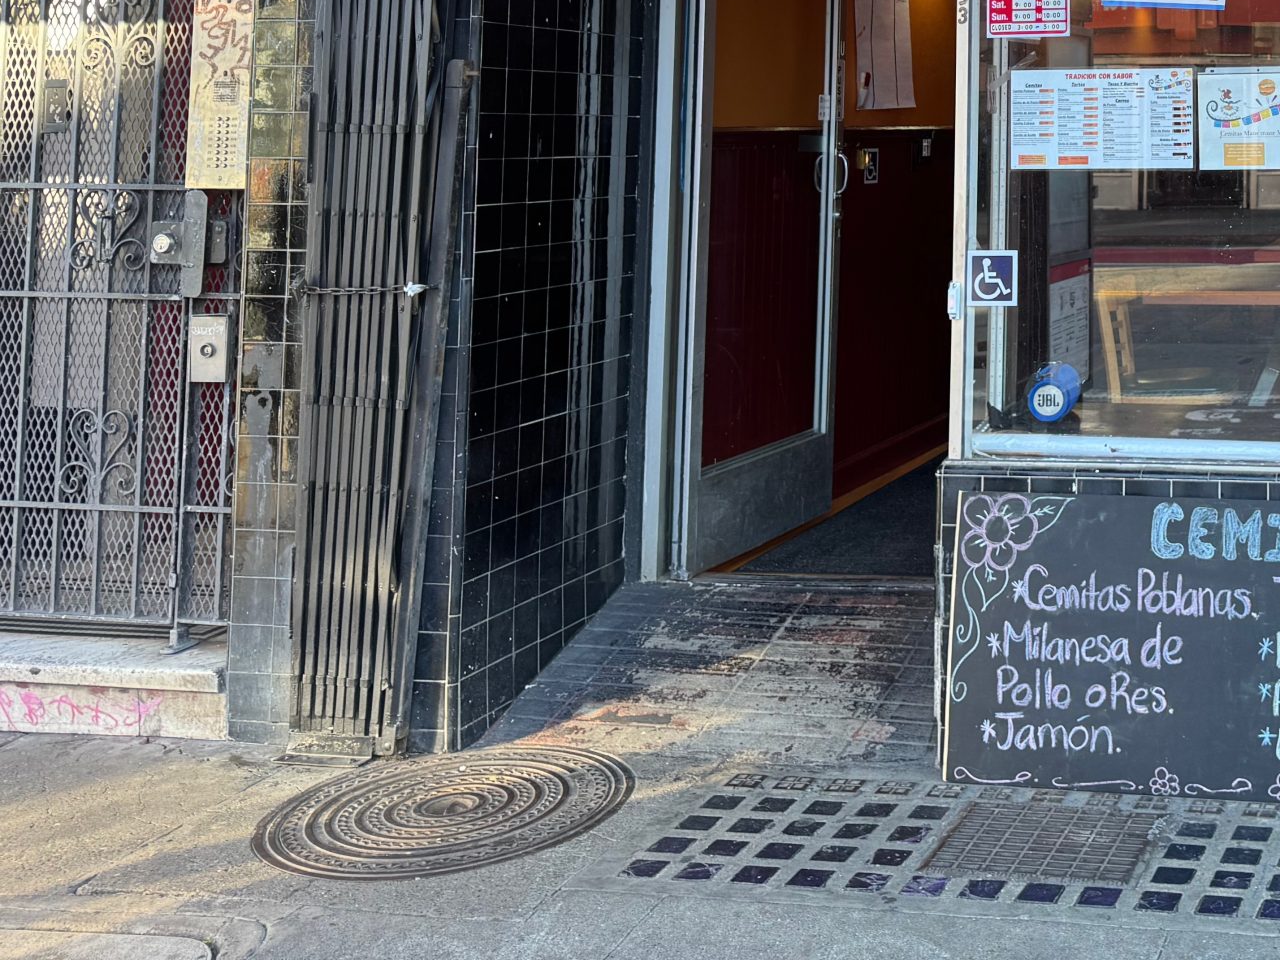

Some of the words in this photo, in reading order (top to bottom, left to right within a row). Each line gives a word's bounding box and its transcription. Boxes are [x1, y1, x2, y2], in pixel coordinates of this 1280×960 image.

[1037, 394, 1060, 407] JBL
[1003, 619, 1131, 666] Milanesa
[1140, 621, 1184, 669] de
[996, 664, 1071, 710] Pollo
